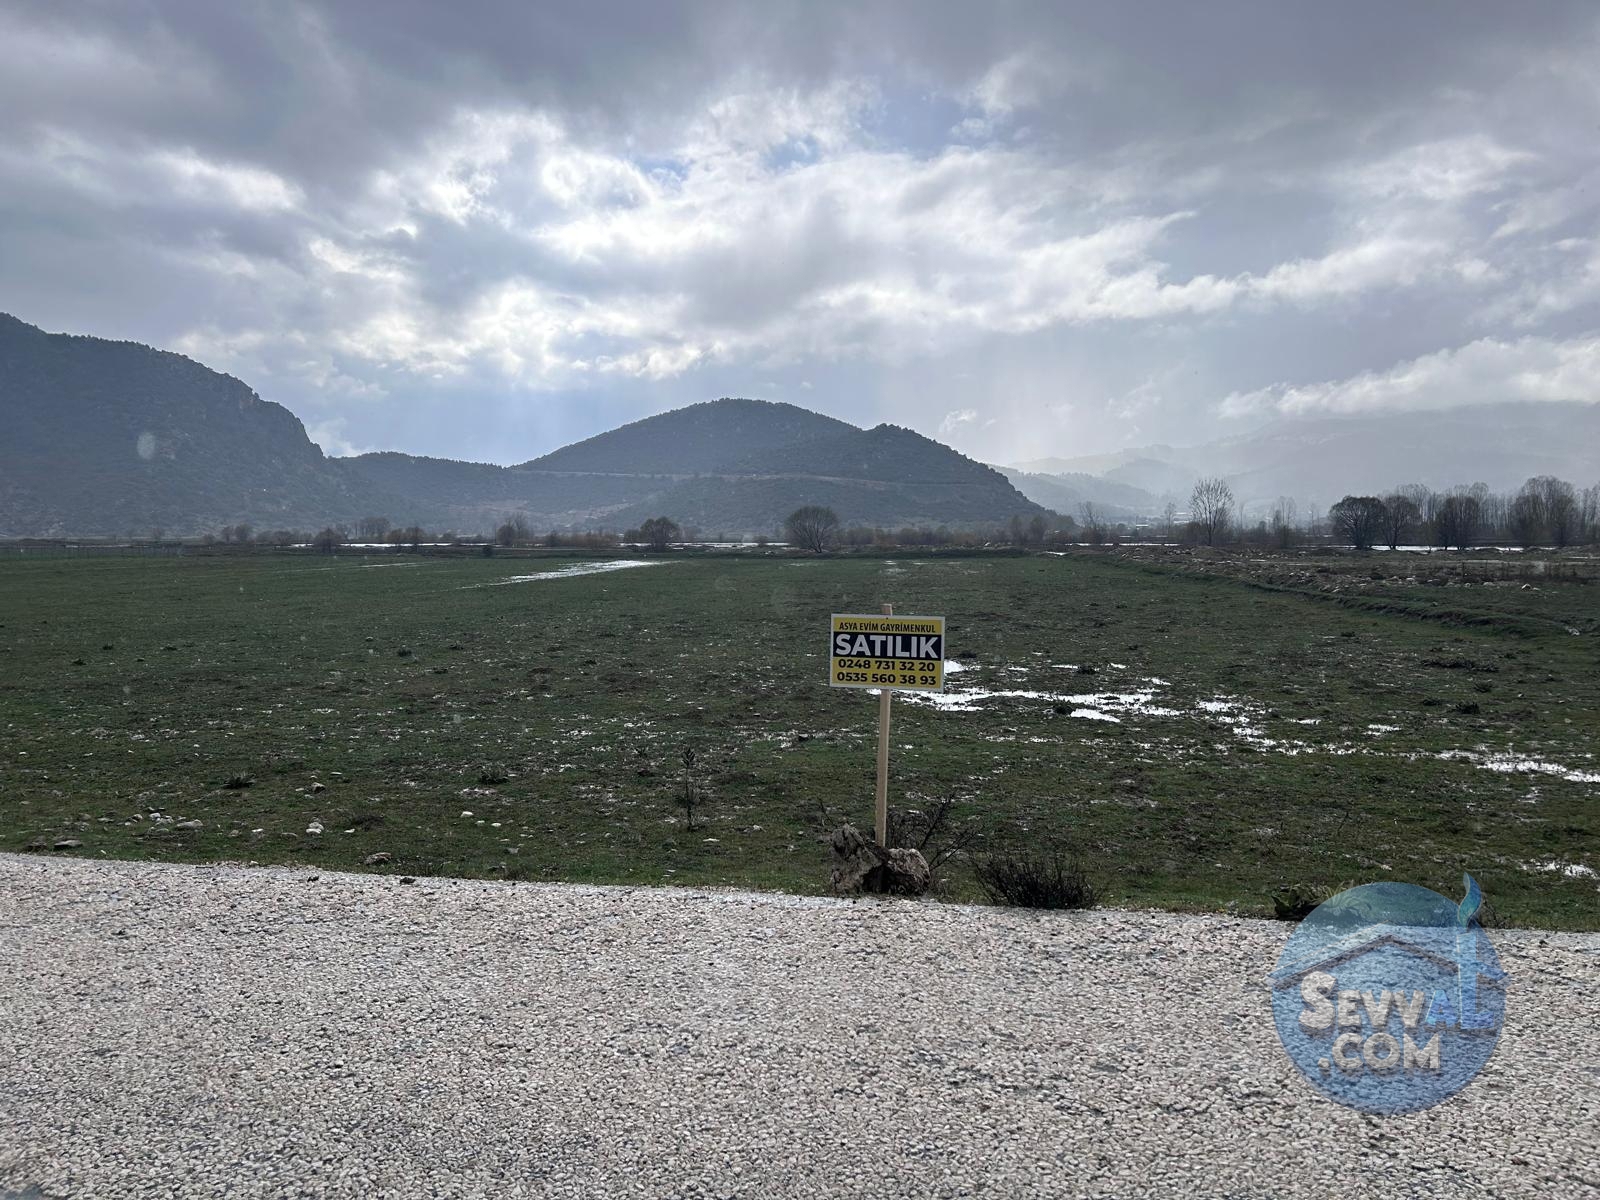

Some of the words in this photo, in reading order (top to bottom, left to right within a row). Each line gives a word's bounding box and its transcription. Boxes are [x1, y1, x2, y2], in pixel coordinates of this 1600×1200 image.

[839, 622, 858, 631] ASYA
[859, 621, 879, 631] EVİM
[880, 622, 936, 633] GAYRİMENKUL
[835, 633, 939, 659] SATILIK
[838, 659, 871, 669] 0248
[874, 660, 896, 671] 731
[899, 661, 915, 671] 32
[918, 662, 935, 672] 20
[837, 671, 868, 682] 0535
[871, 673, 896, 684] 560
[899, 674, 916, 685] 38
[919, 675, 936, 686] 93
